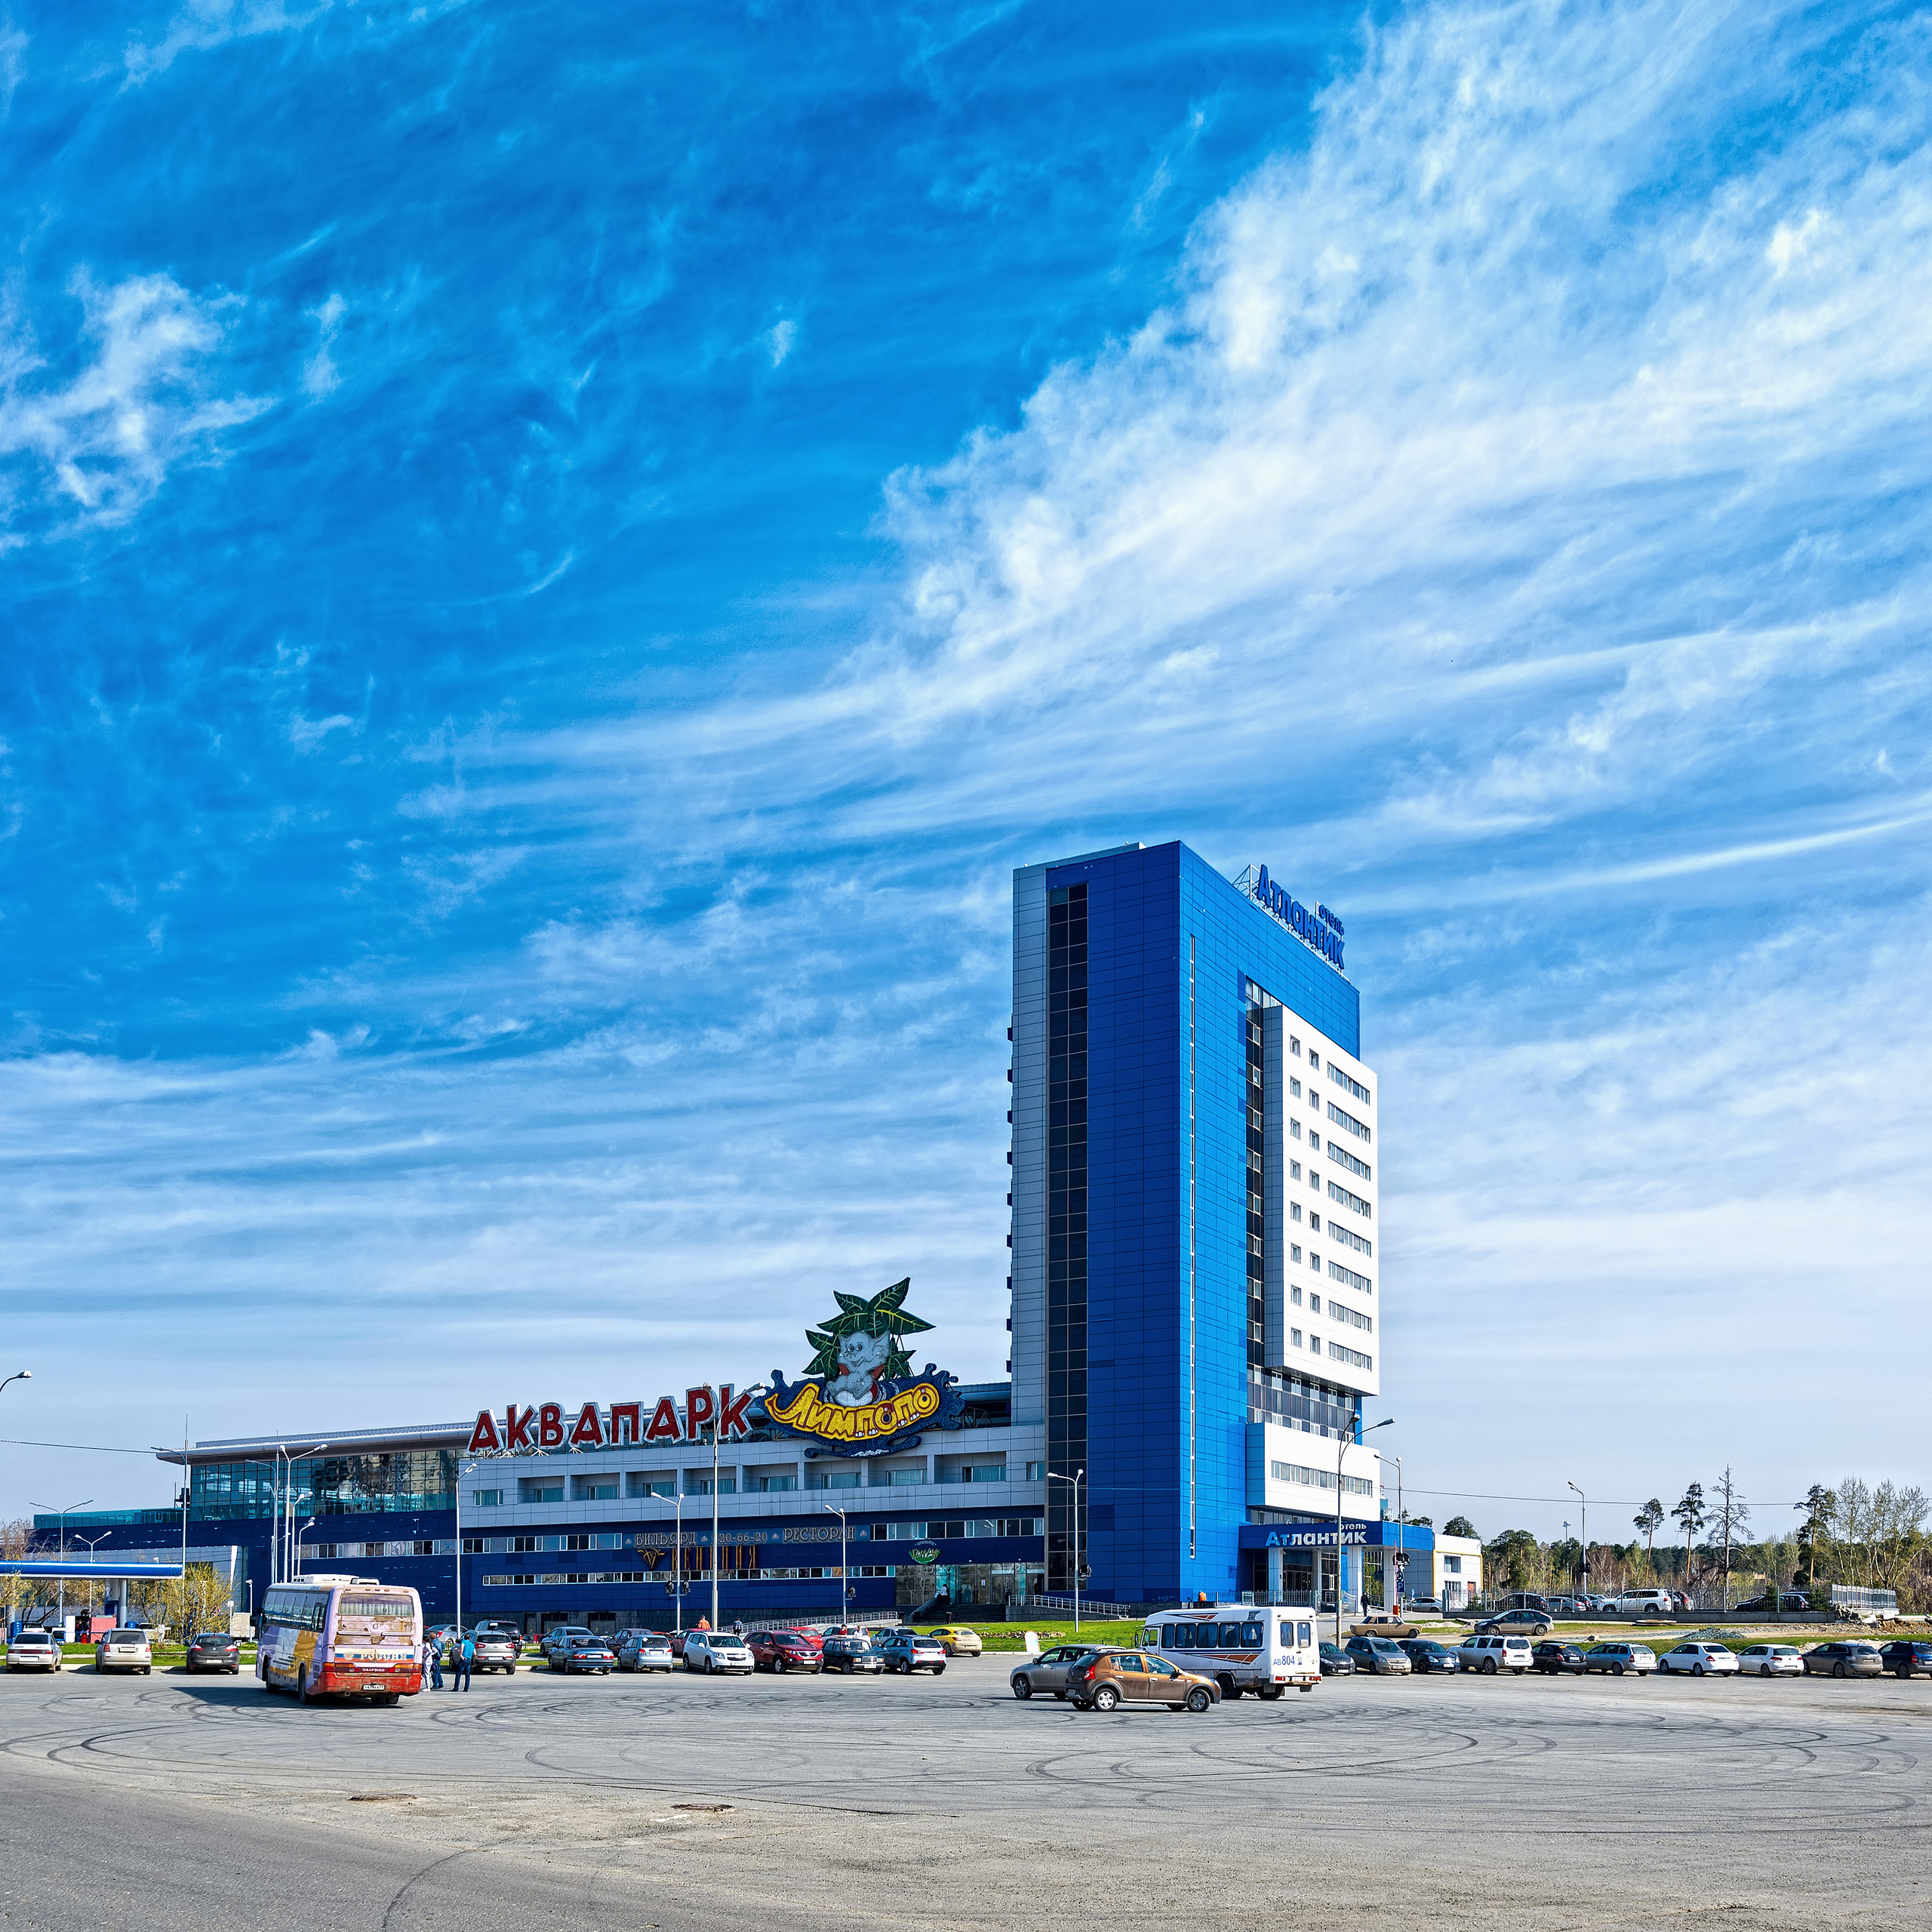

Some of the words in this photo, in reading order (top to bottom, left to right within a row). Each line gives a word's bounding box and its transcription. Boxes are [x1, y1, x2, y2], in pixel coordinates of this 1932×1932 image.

[1257, 864, 1345, 969] Атлантик
[1319, 904, 1344, 935] отель
[465, 1383, 755, 1455] АКВАПАРК
[635, 1532, 697, 1546] БИЛЬЯРД
[711, 1532, 767, 1543] 20-66-20
[783, 1526, 854, 1542] РЕСТОРАН
[1265, 1531, 1367, 1546] Атлантик
[1398, 1582, 1404, 1591] P
[361, 1653, 408, 1661] РОССИЯ
